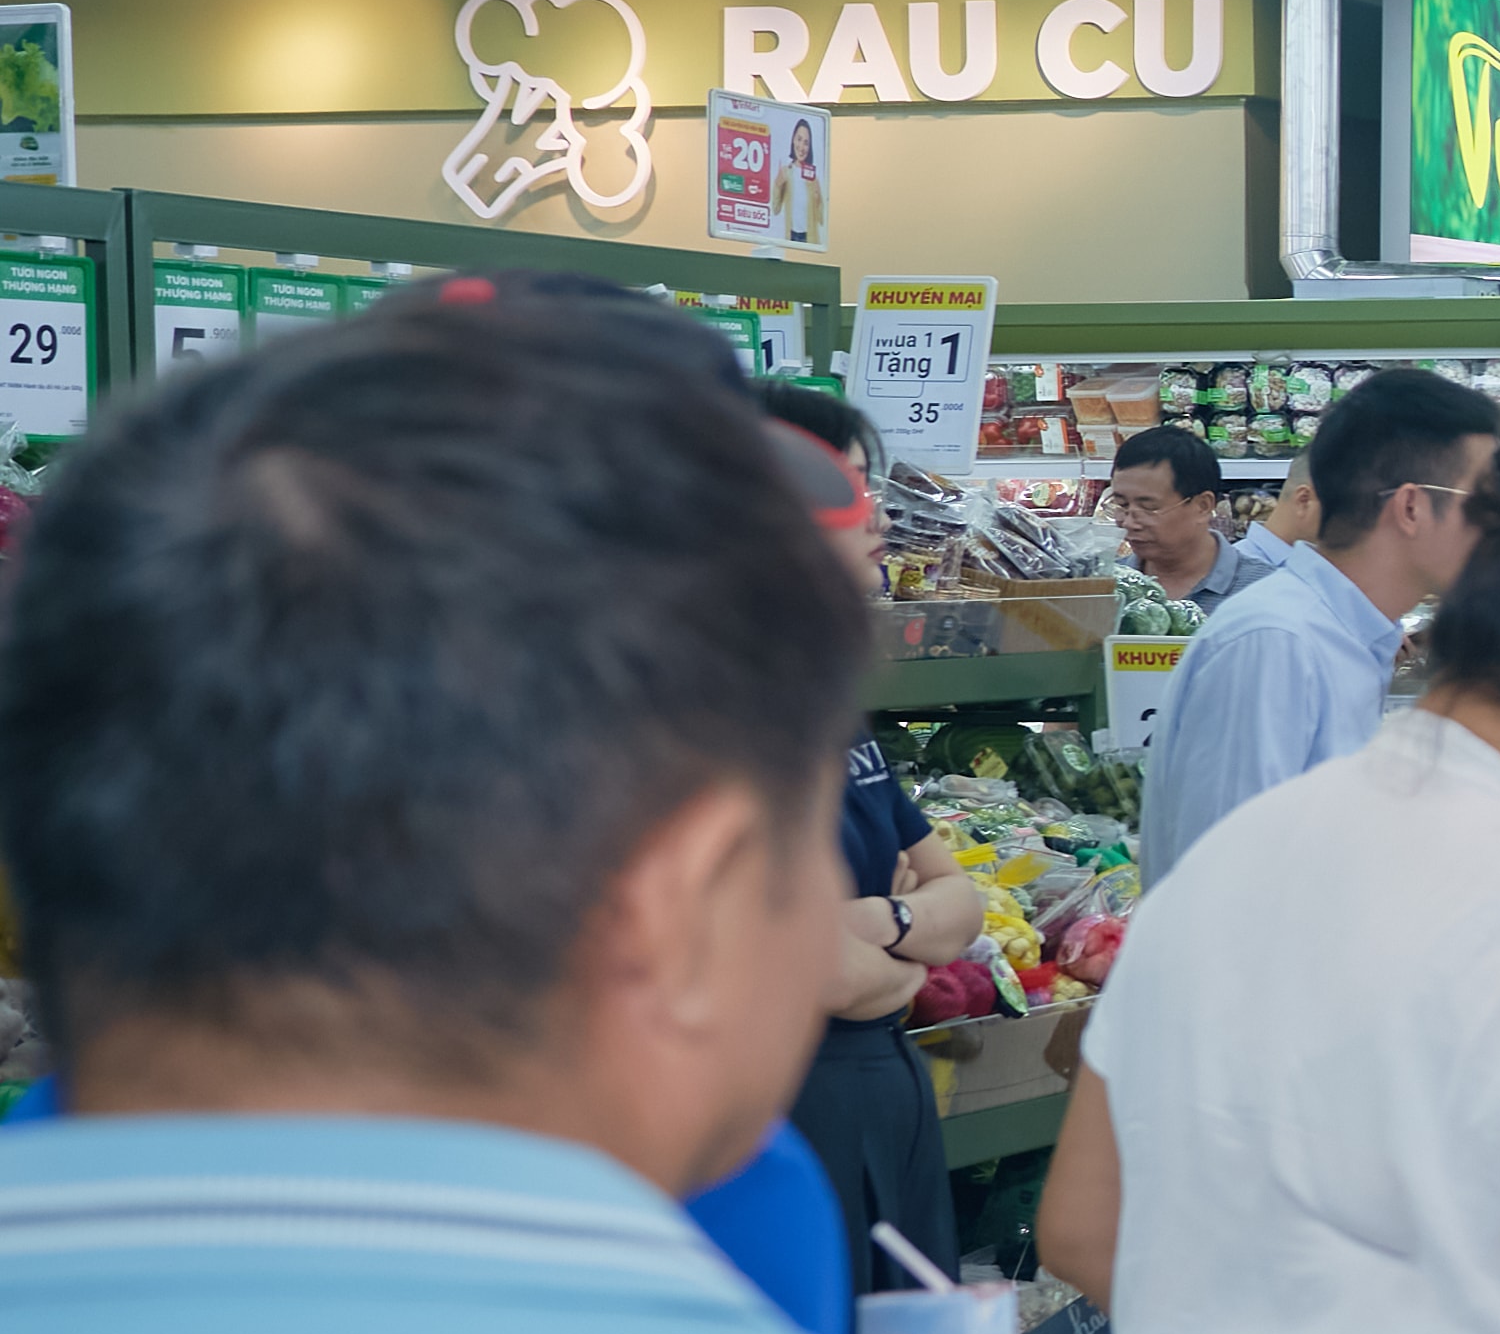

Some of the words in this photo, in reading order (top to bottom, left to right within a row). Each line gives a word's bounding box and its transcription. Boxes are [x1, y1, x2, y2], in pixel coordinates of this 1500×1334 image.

[723, 0, 1003, 103] RAU
[35, 268, 68, 280] NGON
[190, 276, 224, 288] NGON
[2, 280, 46, 294] THƯỢNG
[47, 282, 77, 296] HẠNG
[155, 287, 201, 301] THƯỢNG
[203, 289, 233, 303] HẠNG
[296, 285, 324, 298] NGON
[870, 287, 943, 305] KHUYẾN
[948, 290, 983, 308] MẠI
[8, 323, 58, 364] 29
[923, 331, 932, 348] 1
[874, 352, 931, 378] Tặng
[940, 332, 961, 375] 1
[908, 402, 939, 423] 35
[1117, 647, 1184, 666] KHUYẾ
